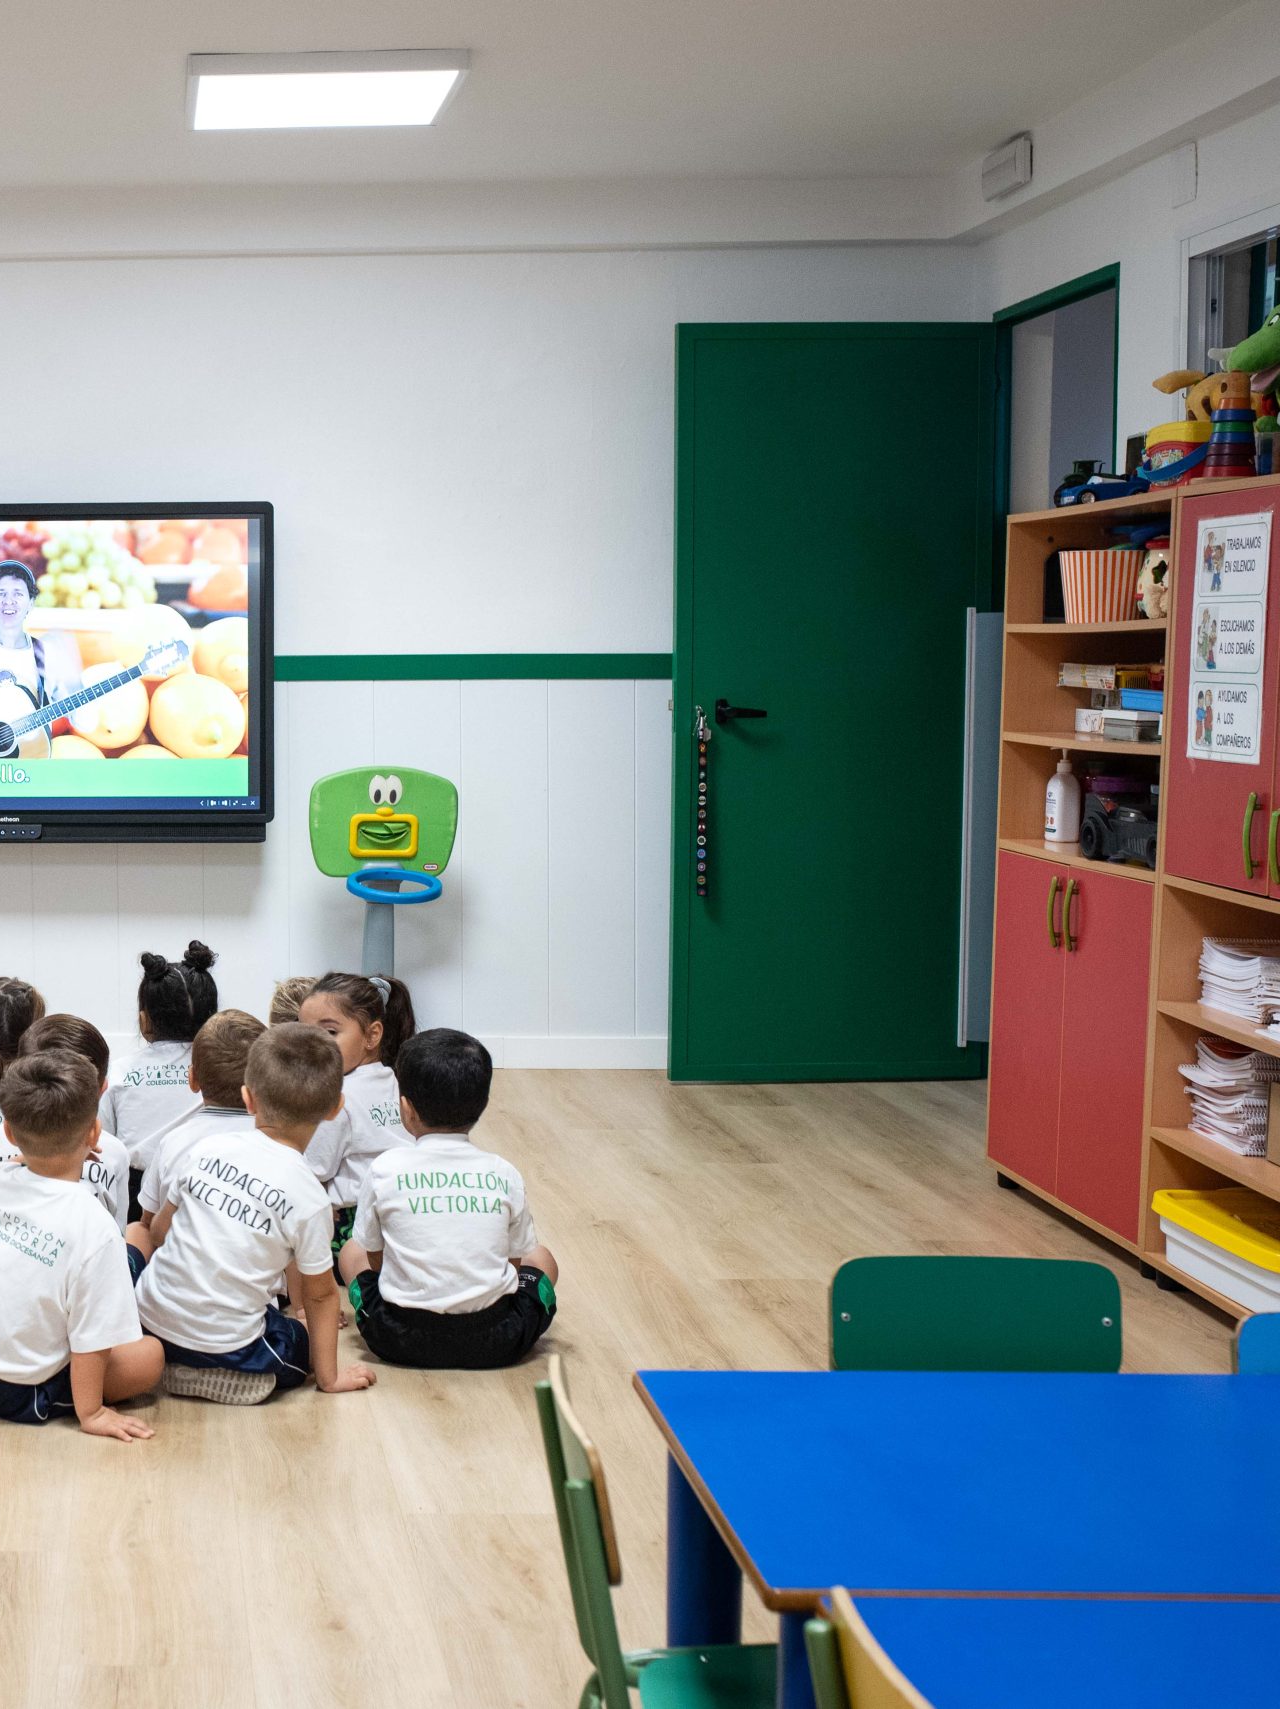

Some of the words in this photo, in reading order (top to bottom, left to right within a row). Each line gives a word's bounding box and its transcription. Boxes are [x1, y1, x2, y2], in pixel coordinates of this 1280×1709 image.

[1226, 536, 1262, 550] TRABAJAMOS
[1224, 561, 1232, 573] EN
[1233, 559, 1256, 572] SILENCIO
[1220, 619, 1255, 632] ESCUCHAMOS
[1219, 642, 1224, 655] A
[1224, 642, 1235, 655] LOS
[1236, 639, 1255, 655] DEMÁS
[1217, 690, 1248, 703] AYUDAMOS
[1216, 712, 1222, 725] A
[1223, 712, 1234, 725] LOS
[1216, 732, 1252, 749] COMPAÑEROS
[145, 1079, 178, 1087] COLEGIOS
[199, 1157, 295, 1221] UNDACIÓN
[397, 1170, 509, 1195] FUNDACIÓN
[188, 1175, 272, 1236] VICTORIA
[408, 1195, 502, 1214] VICTORIA
